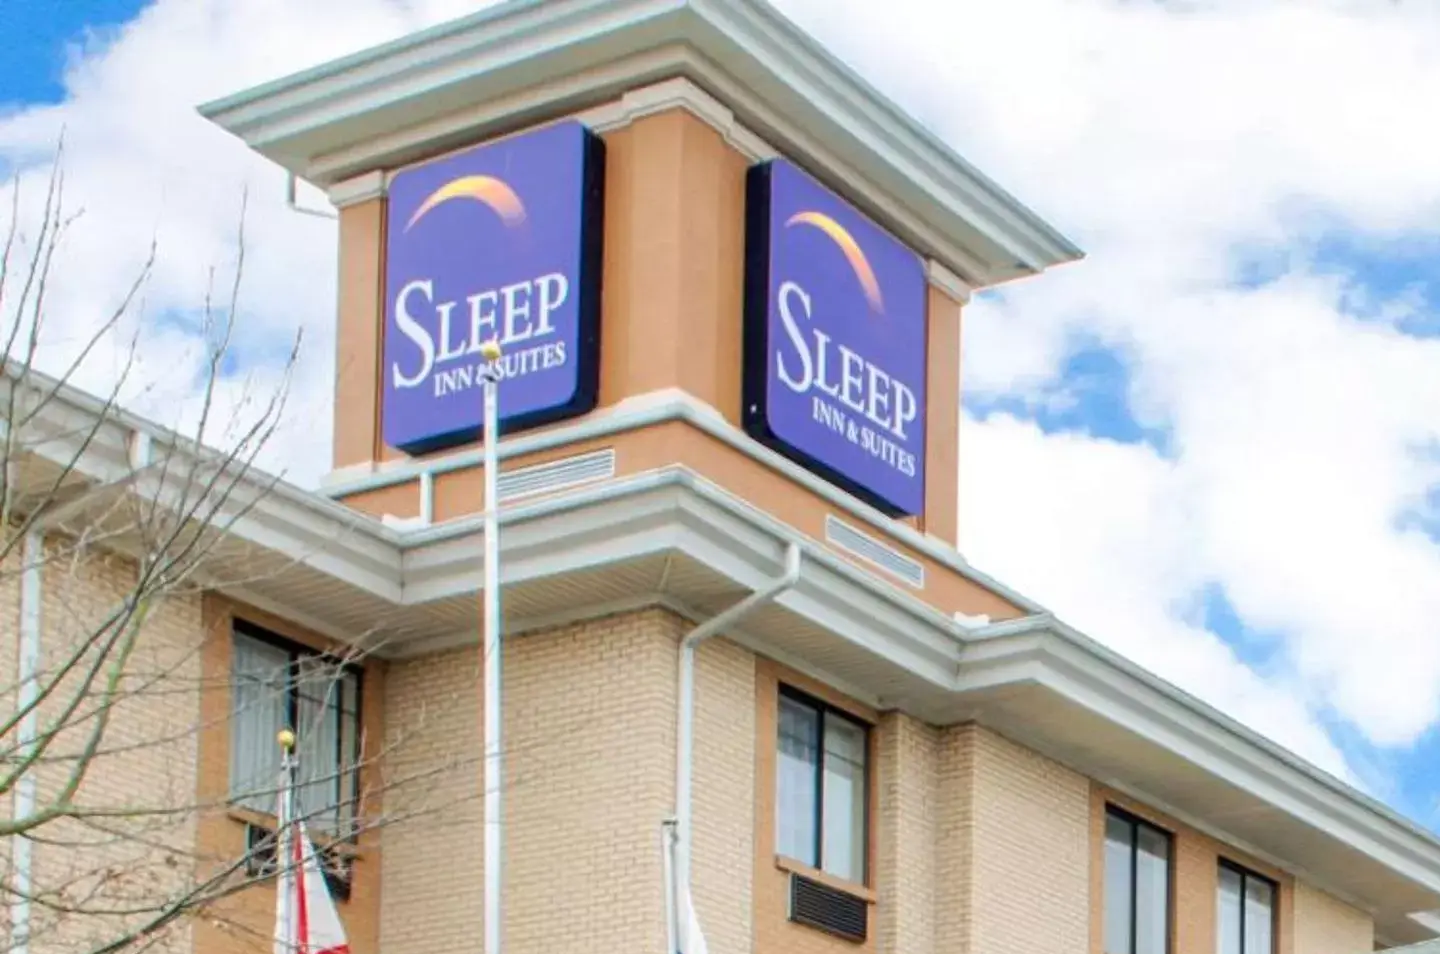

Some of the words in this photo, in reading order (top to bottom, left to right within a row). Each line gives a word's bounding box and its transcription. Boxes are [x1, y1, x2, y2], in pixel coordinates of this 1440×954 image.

[392, 272, 569, 389] SLEEP
[434, 364, 473, 397] INN
[494, 340, 567, 382] SUITES
[776, 281, 916, 441] SLEEP
[812, 396, 846, 436] INN
[847, 419, 859, 445] &
[861, 426, 915, 478] SUITES
